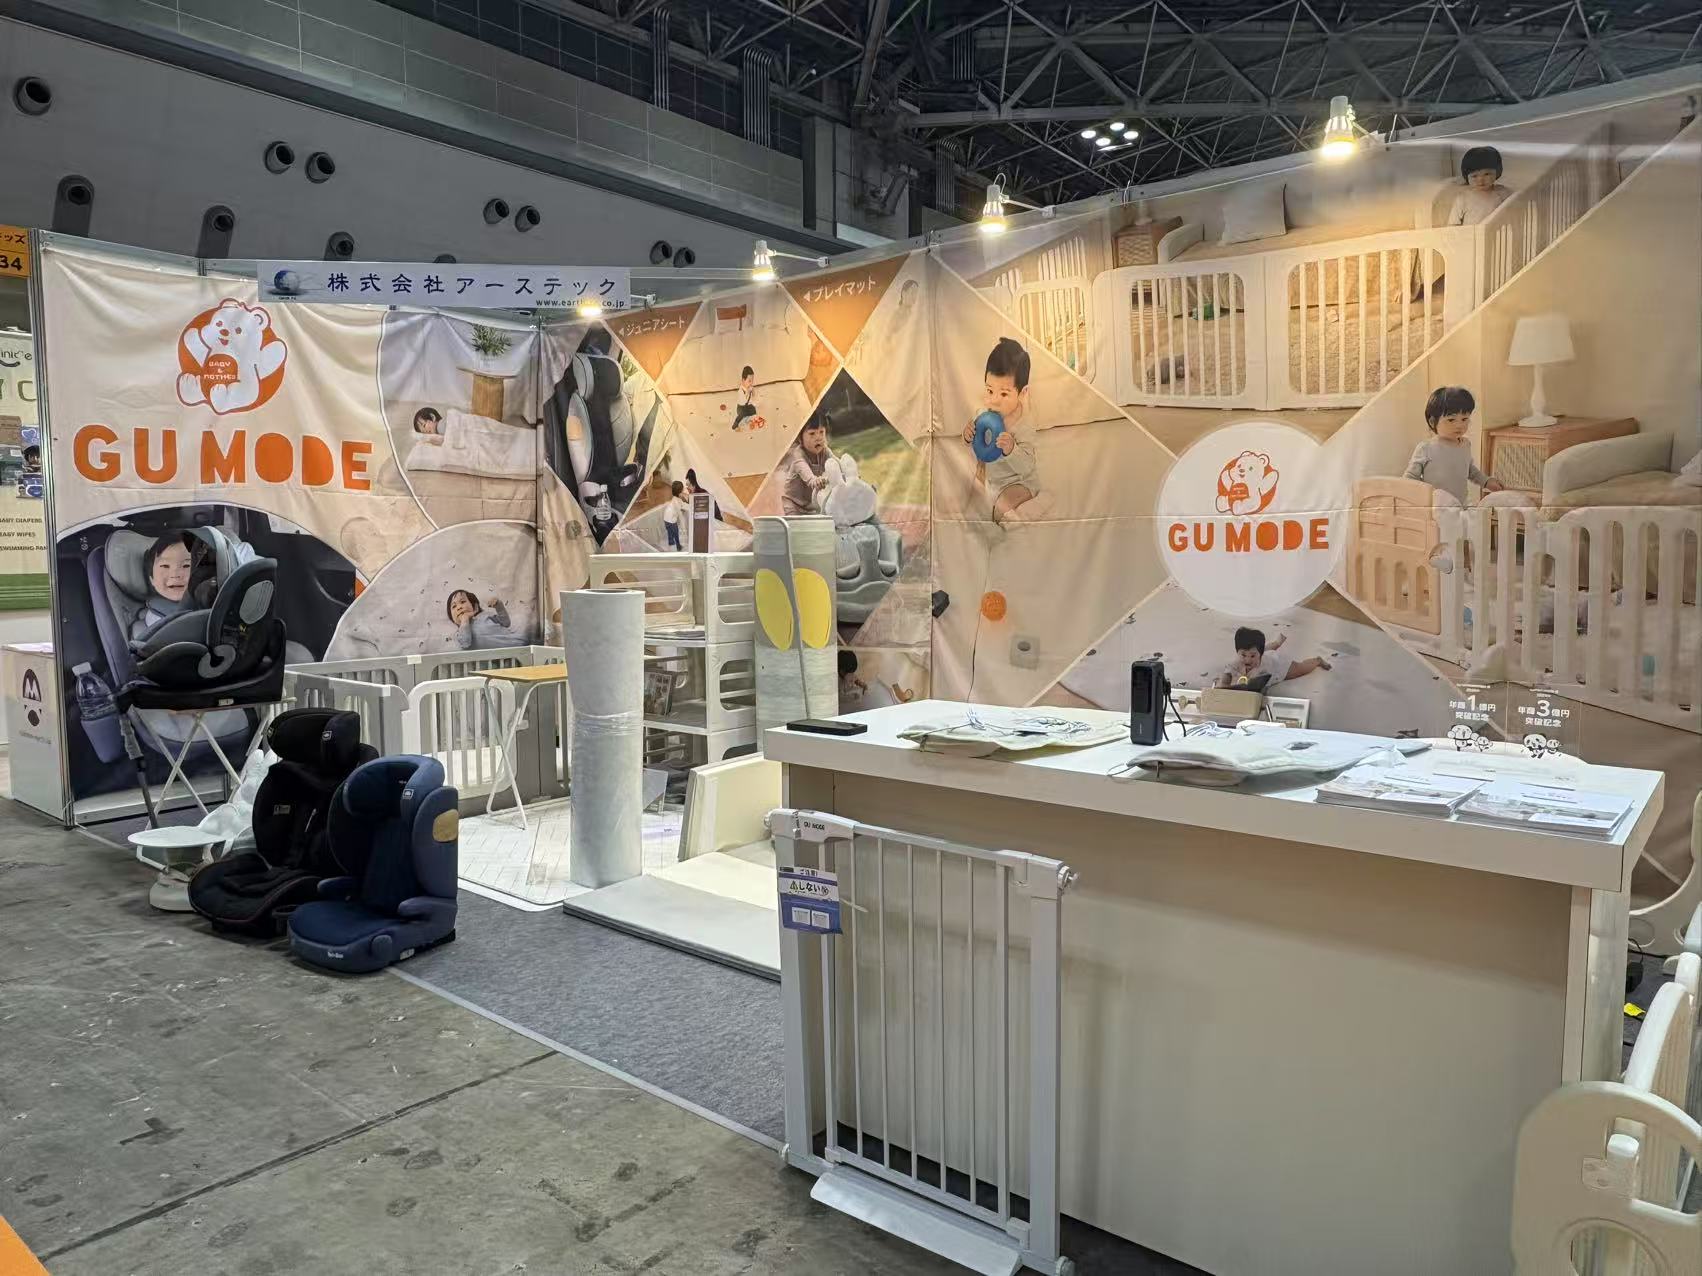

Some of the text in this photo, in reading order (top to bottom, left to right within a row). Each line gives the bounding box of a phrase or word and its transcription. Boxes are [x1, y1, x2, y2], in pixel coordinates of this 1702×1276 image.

[327, 273, 616, 296] 株式会社アーステック
[626, 315, 686, 337] ジュニアシート
[73, 424, 374, 491] GU MODE
[1168, 518, 1329, 552] GU MODE
